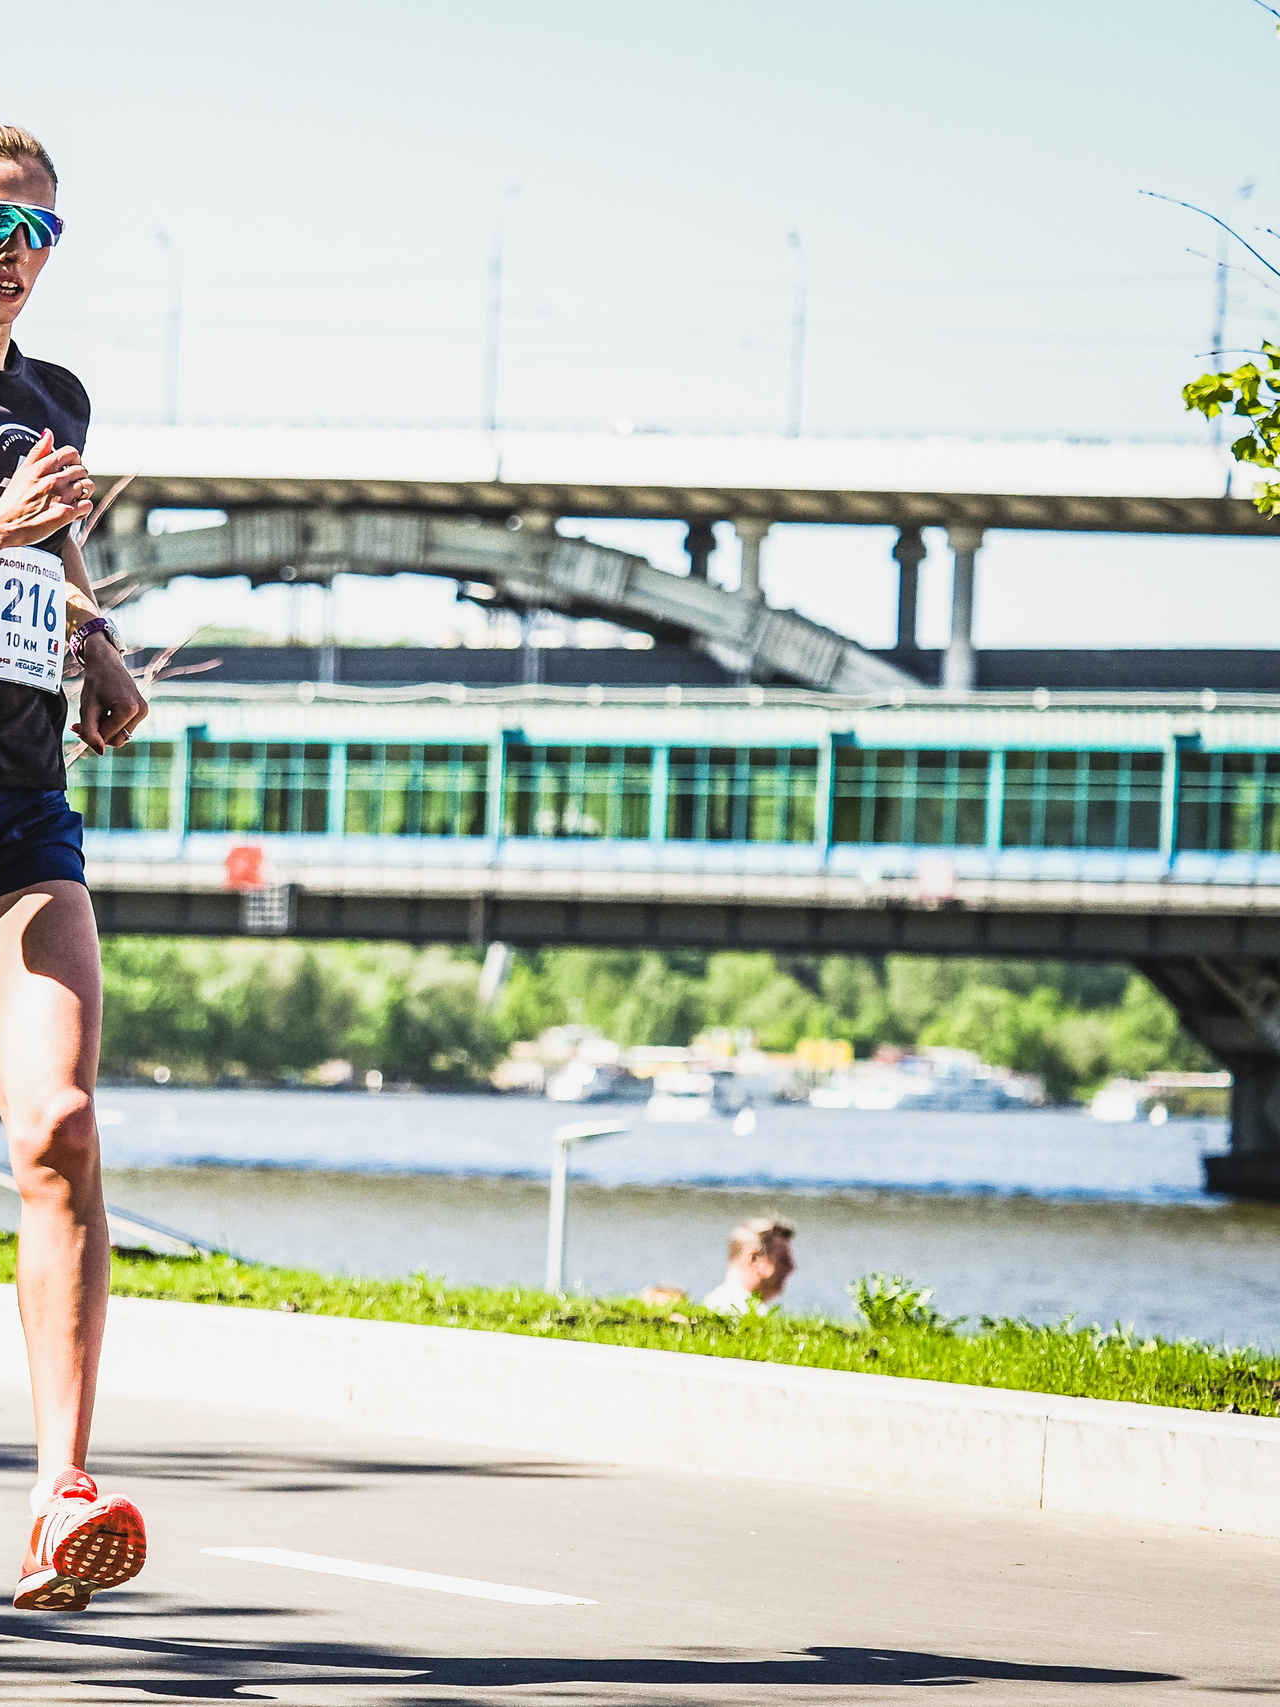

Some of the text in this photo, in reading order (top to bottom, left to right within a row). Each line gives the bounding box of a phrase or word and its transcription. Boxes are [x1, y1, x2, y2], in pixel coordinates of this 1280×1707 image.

[1, 434, 23, 452] ADIDAS
[26, 563, 41, 575] ПУТЬ
[1, 577, 57, 633] 216
[6, 631, 38, 652] 10 КМ
